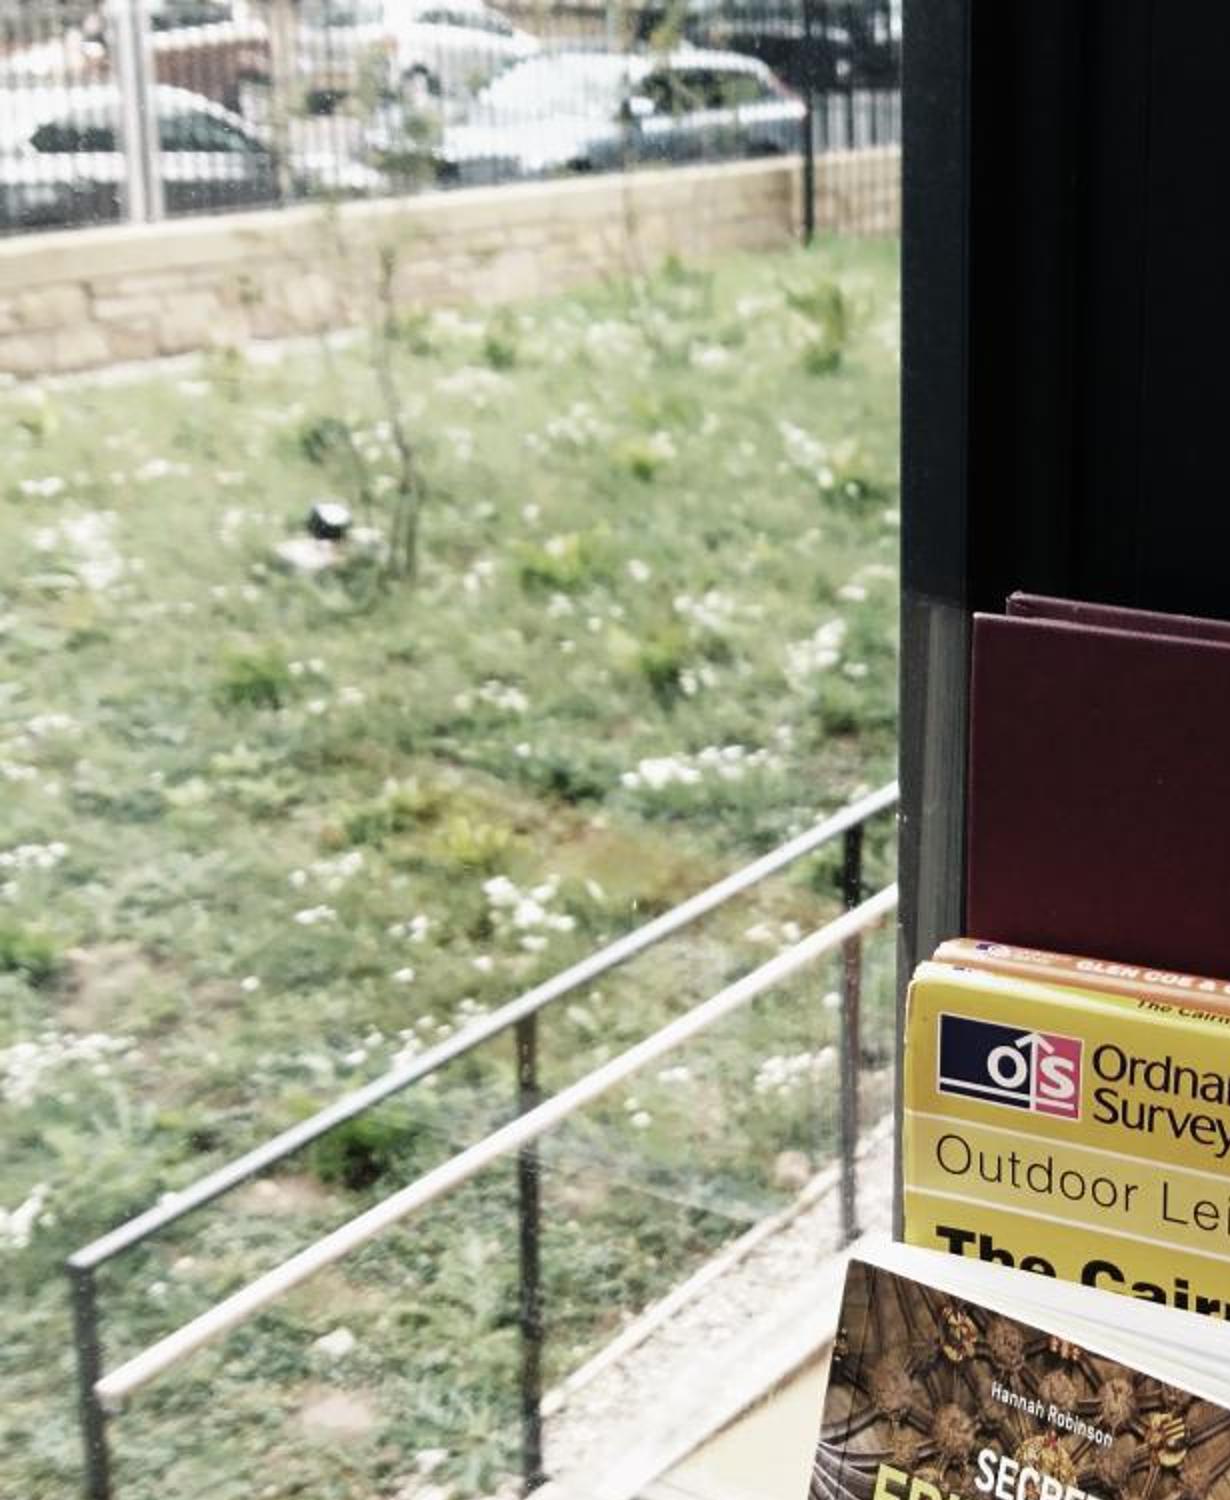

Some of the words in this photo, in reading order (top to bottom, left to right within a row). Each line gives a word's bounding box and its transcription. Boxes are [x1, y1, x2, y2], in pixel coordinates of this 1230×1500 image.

[1075, 959, 1138, 979] GLEN
[1142, 969, 1194, 987] COE
[1137, 999, 1175, 1014] The
[936, 1134, 1138, 1212] Outdoor
[991, 1381, 1045, 1418] Hannah
[1047, 1404, 1113, 1448] Robinson
